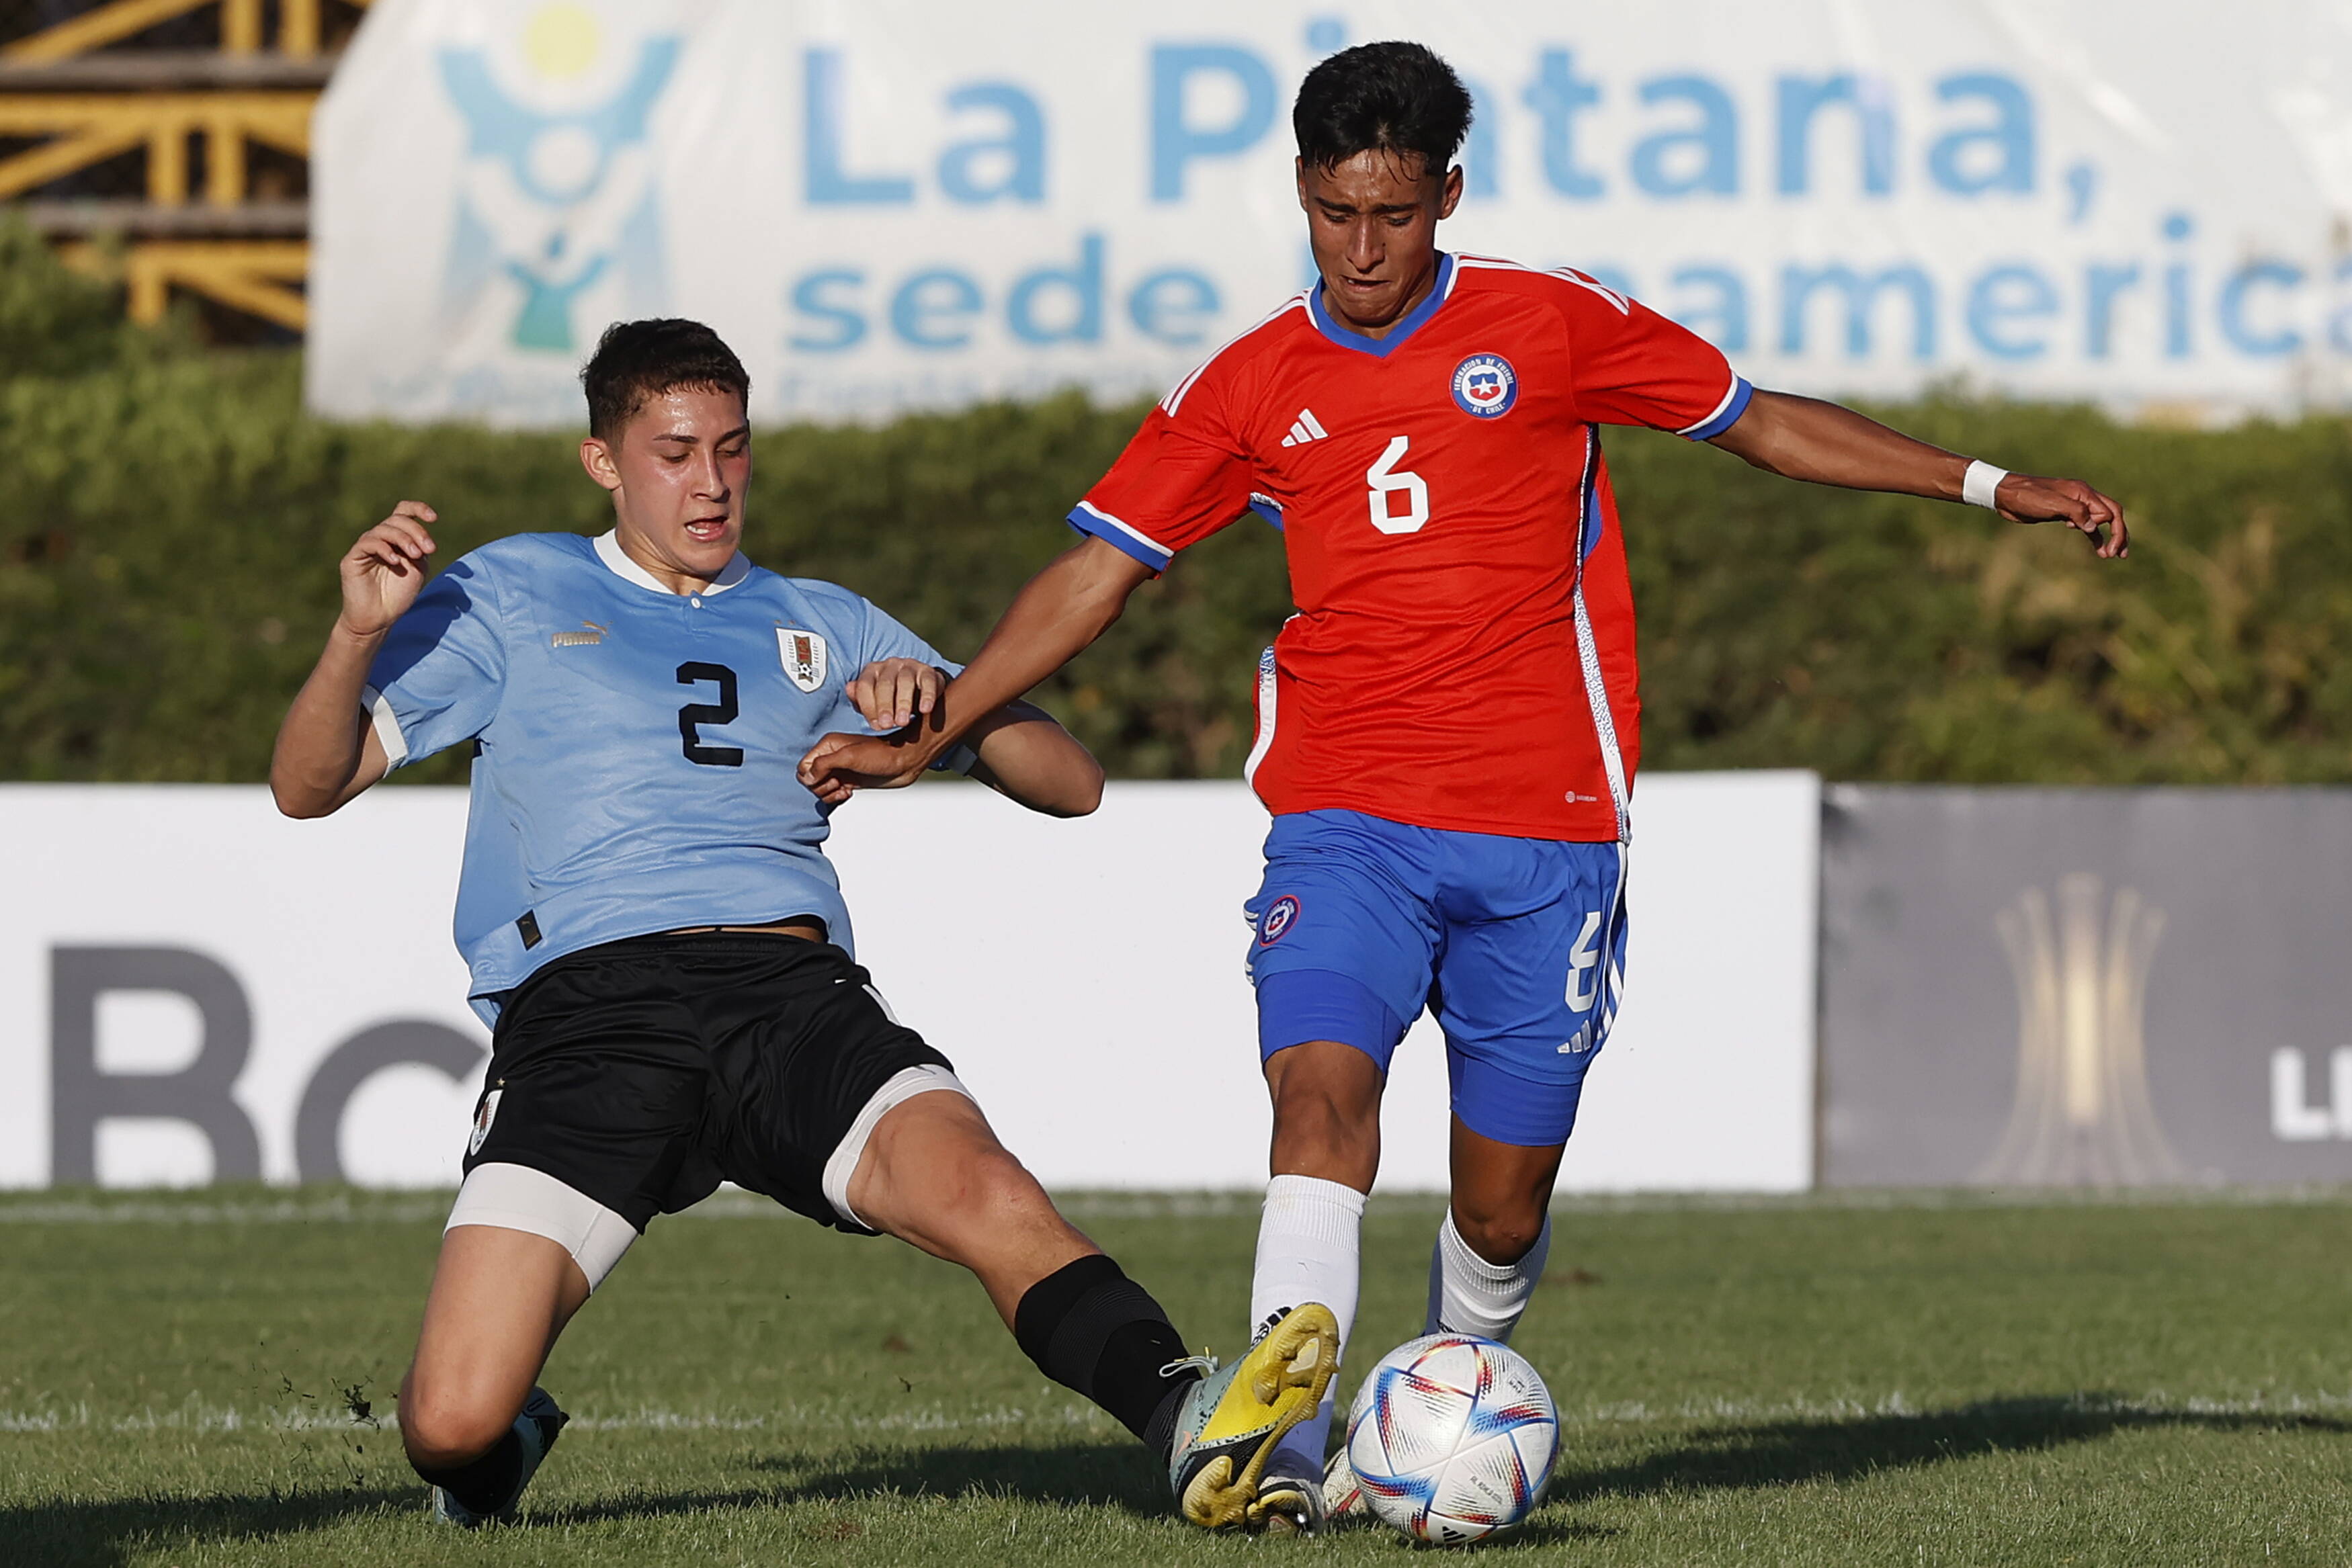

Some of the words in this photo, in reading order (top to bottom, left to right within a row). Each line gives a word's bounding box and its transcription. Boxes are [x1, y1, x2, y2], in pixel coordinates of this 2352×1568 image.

[803, 47, 1046, 205] La
[788, 232, 1220, 353] sede
[1367, 435, 1429, 534] 6
[676, 661, 744, 767] 2
[1564, 911, 1601, 1012] 6
